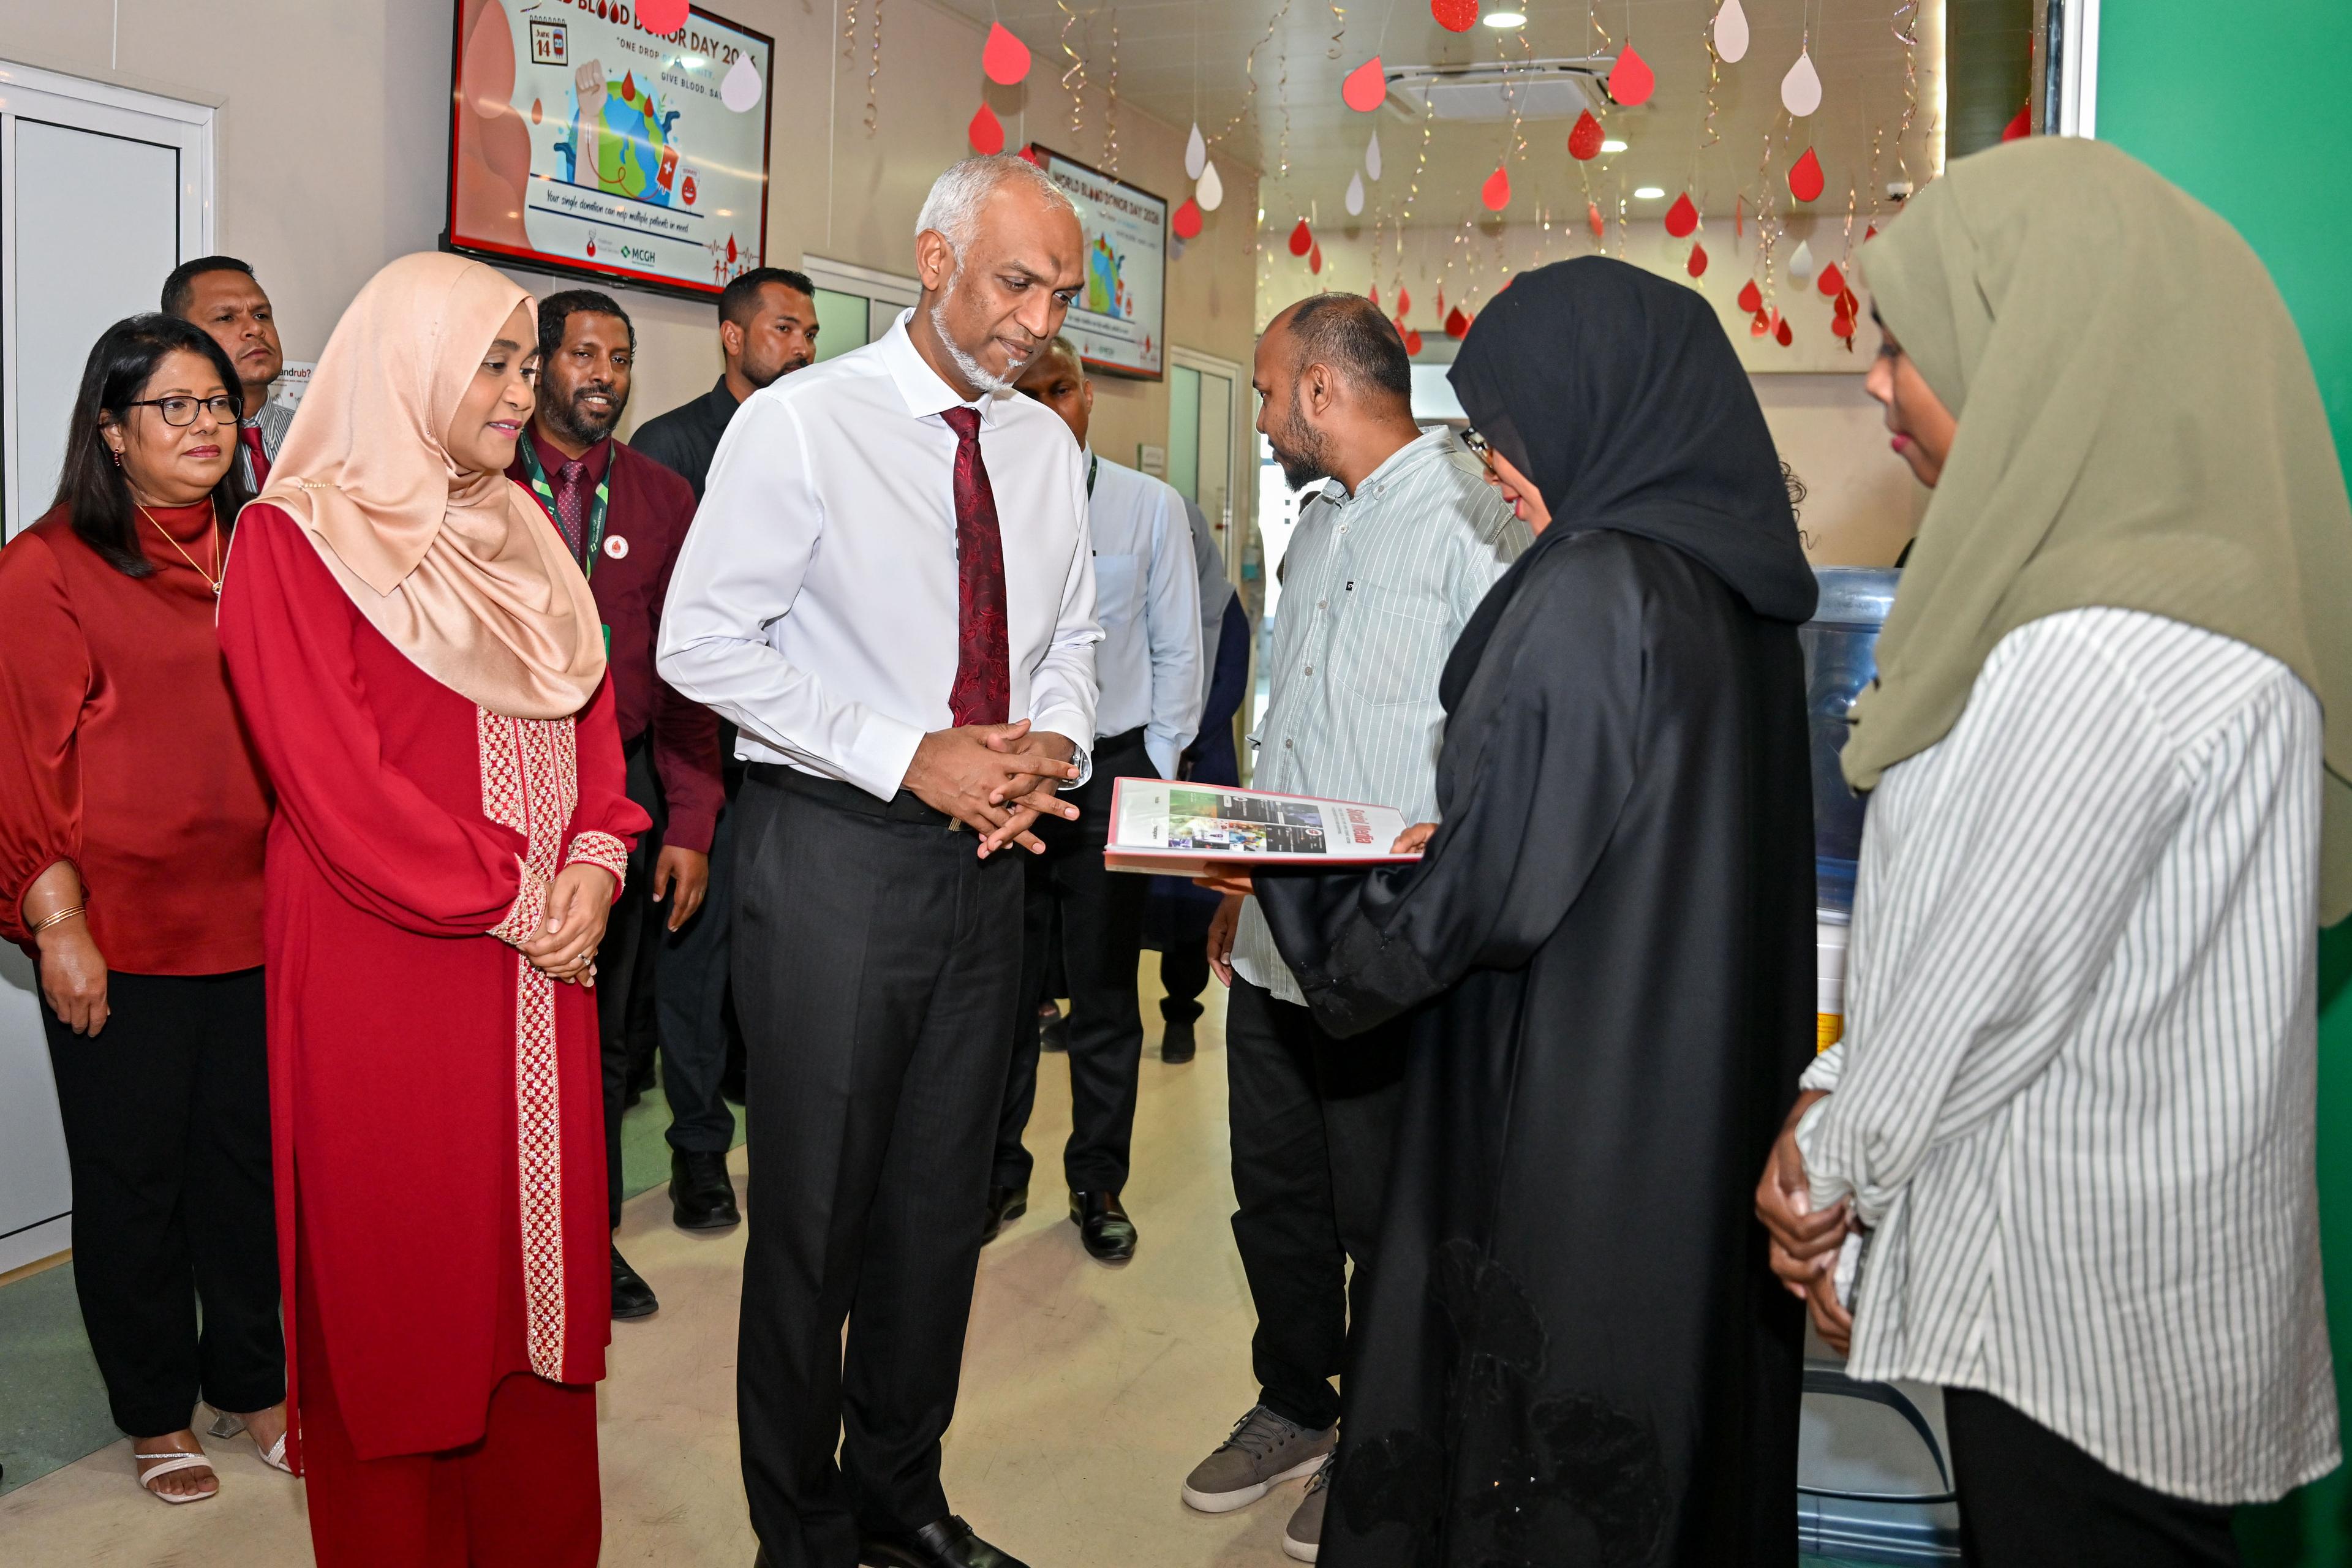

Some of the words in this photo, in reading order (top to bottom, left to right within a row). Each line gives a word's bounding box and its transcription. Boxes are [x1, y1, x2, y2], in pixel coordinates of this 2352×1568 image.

[536, 29, 549, 38] June
[635, 14, 687, 49] DOR
[691, 32, 719, 58] DAY
[537, 39, 551, 57] 14
[639, 45, 659, 59] DROP
[662, 72, 677, 86] GIVE
[681, 78, 707, 96] BLOOD.
[547, 189, 559, 203] Your
[561, 195, 578, 210] single
[579, 199, 603, 213] donation
[629, 211, 648, 227] multiple
[649, 216, 668, 229] patients
[632, 247, 655, 263] MCGH
[279, 368, 311, 377] andrub?
[1351, 824, 1374, 843] Media
